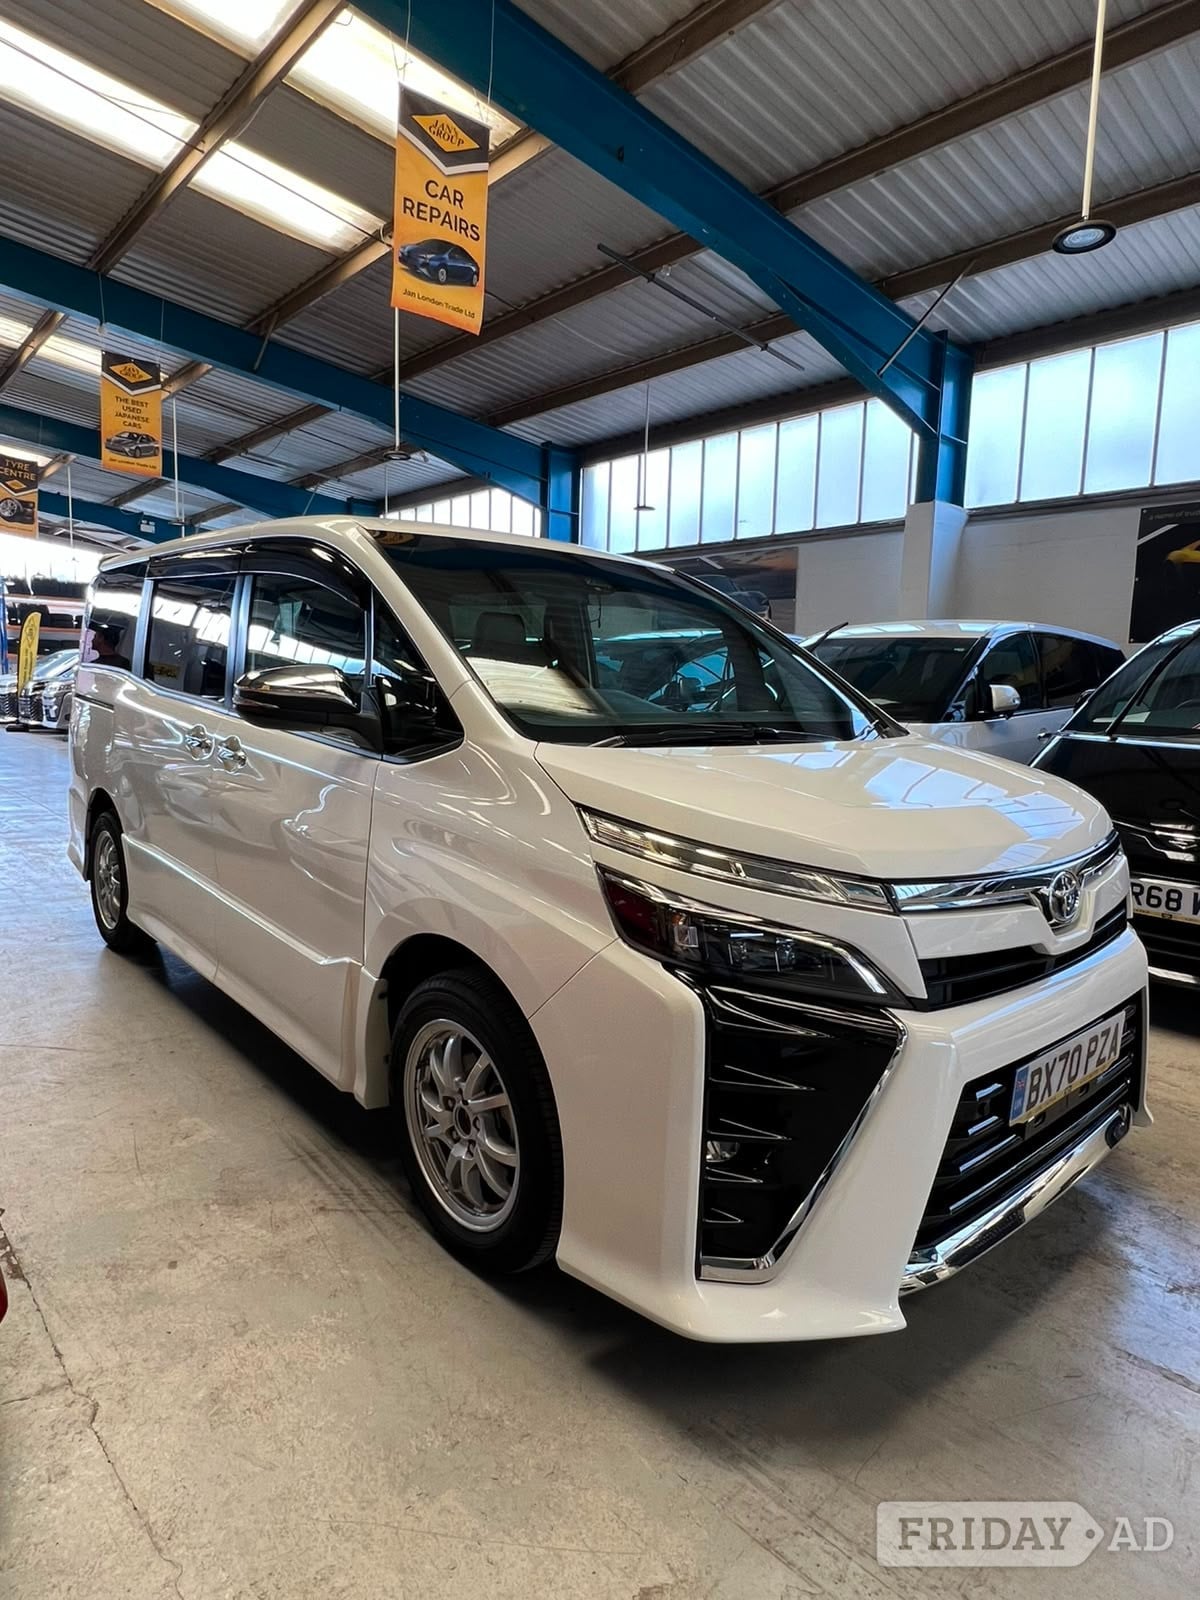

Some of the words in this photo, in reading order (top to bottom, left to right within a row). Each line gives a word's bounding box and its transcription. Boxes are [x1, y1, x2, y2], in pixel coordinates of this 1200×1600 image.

[428, 125, 465, 147] GROUP
[425, 179, 464, 210] CAR
[403, 197, 480, 241] REPAIRS
[402, 288, 416, 298] Jan
[417, 292, 444, 307] London
[444, 302, 464, 314] Trade
[464, 309, 475, 319] Ltd
[114, 395, 129, 404] THE
[130, 398, 149, 408] BEST
[122, 405, 142, 415] USED
[114, 411, 150, 424] JAPANESE
[122, 420, 142, 430] CARS
[5, 459, 30, 472] TYRE
[1025, 1043, 1081, 1113] BX70
[1084, 1021, 1120, 1075] PZA
